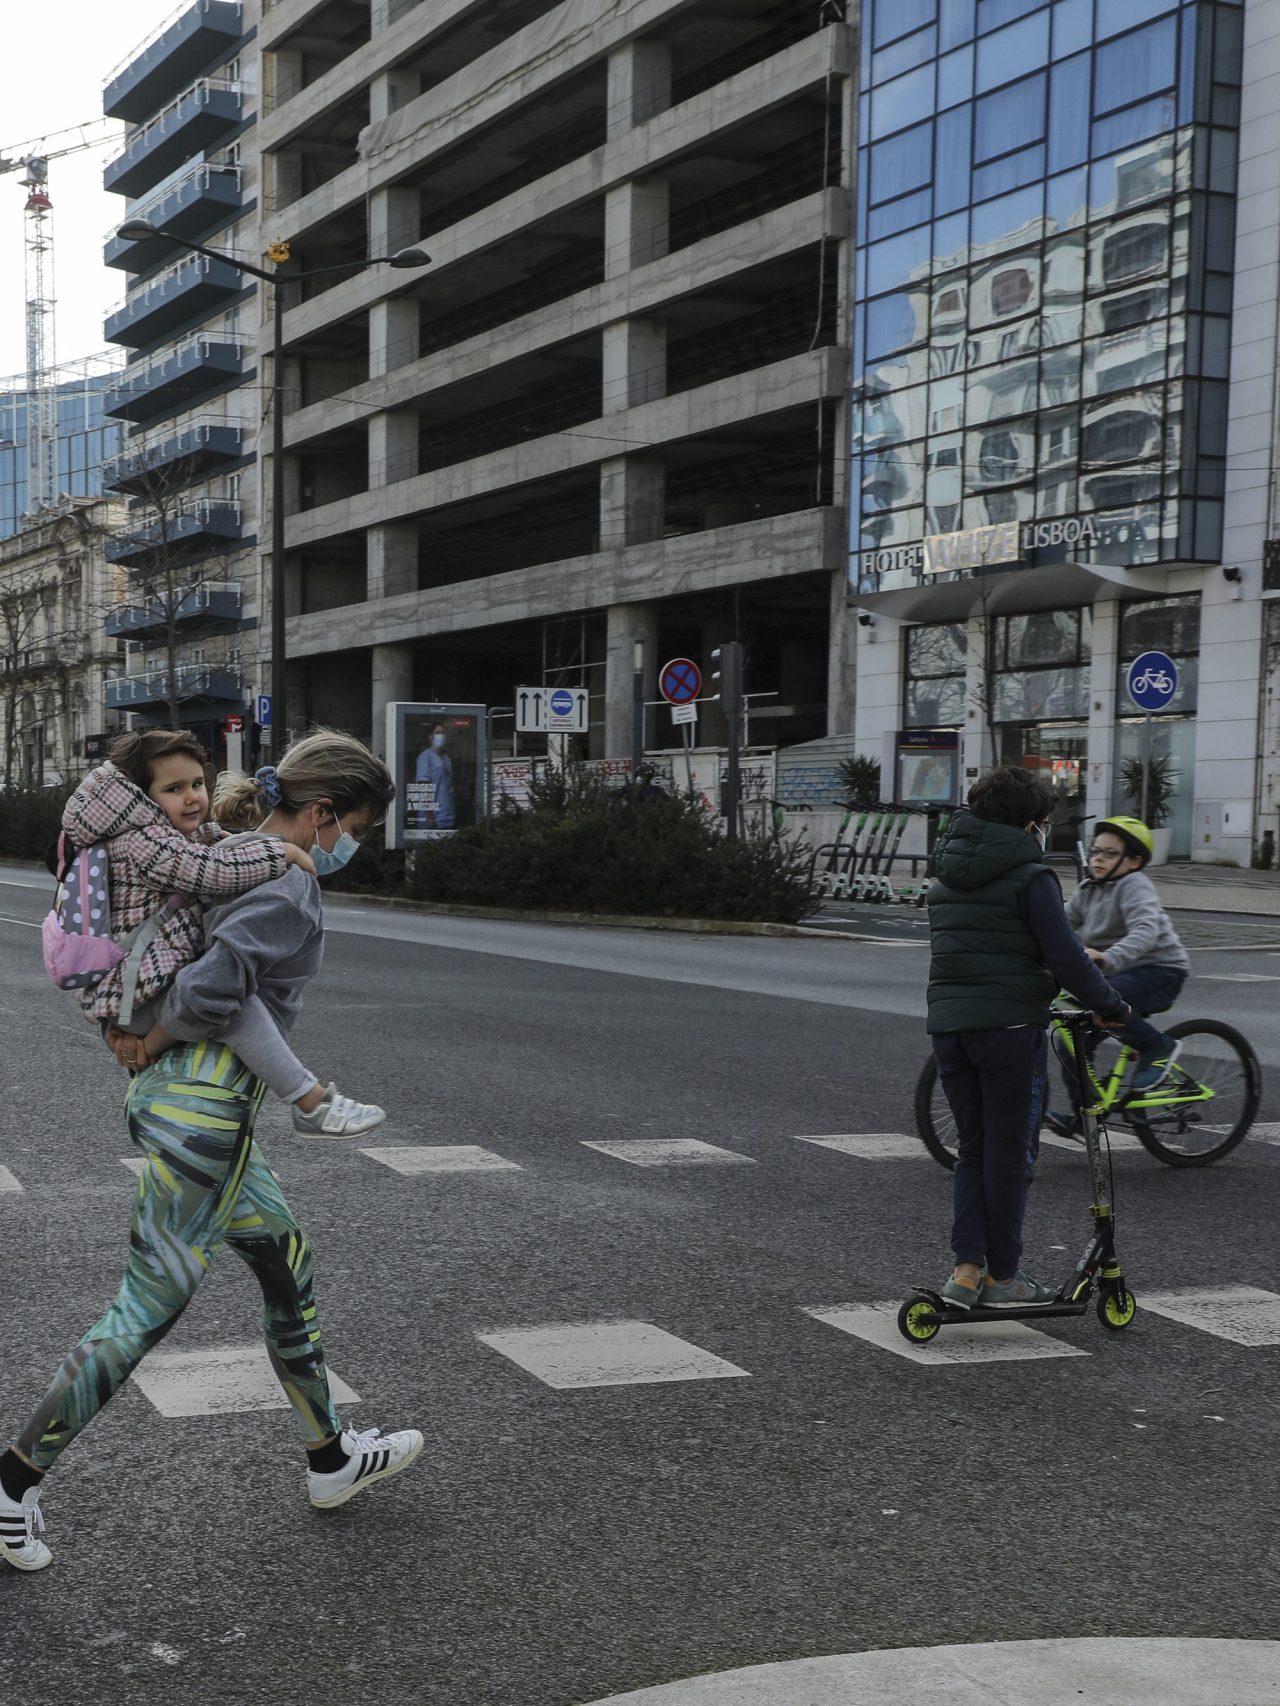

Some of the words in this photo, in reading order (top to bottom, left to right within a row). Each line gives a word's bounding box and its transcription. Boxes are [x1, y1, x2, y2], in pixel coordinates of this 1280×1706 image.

[862, 543, 923, 576] HOTEL
[928, 528, 1016, 570] WHITE
[1023, 517, 1096, 550] LISBOA
[260, 698, 269, 722] P
